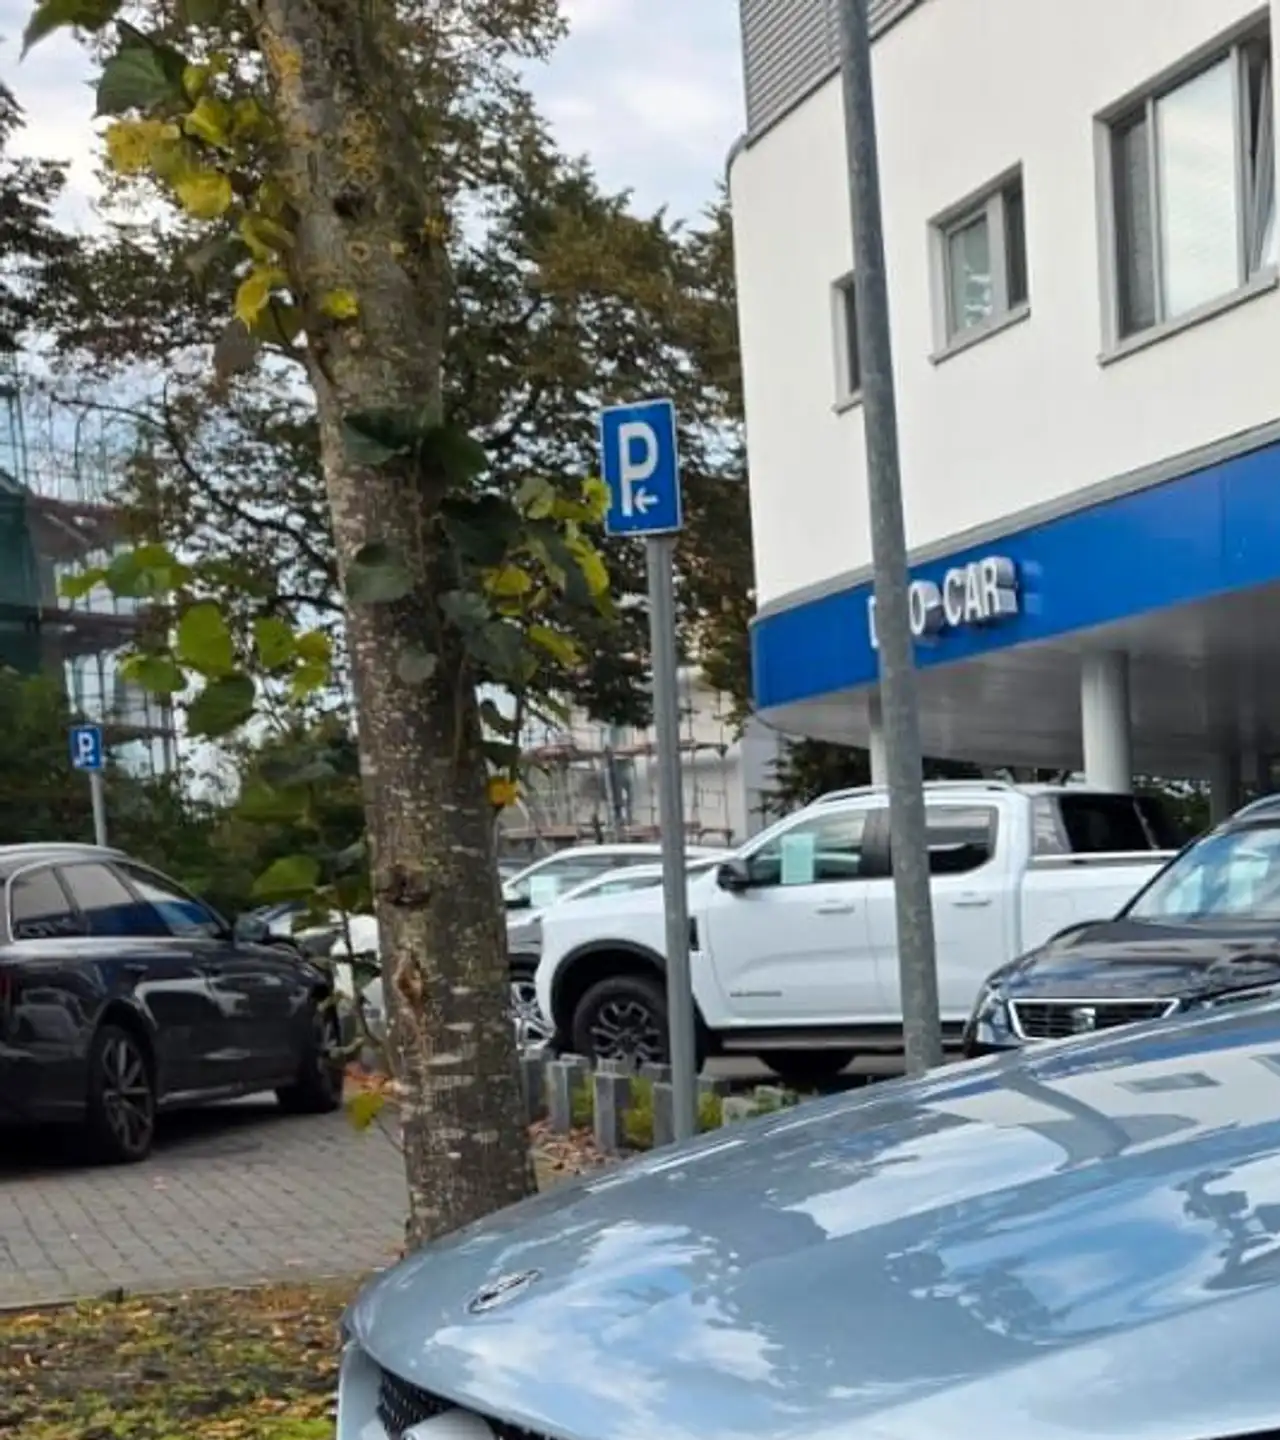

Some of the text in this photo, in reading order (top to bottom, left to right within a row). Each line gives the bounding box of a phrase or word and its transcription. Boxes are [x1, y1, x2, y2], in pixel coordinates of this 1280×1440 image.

[618, 421, 659, 517] P
[867, 556, 1018, 650] O-CAR
[78, 731, 94, 767] P
